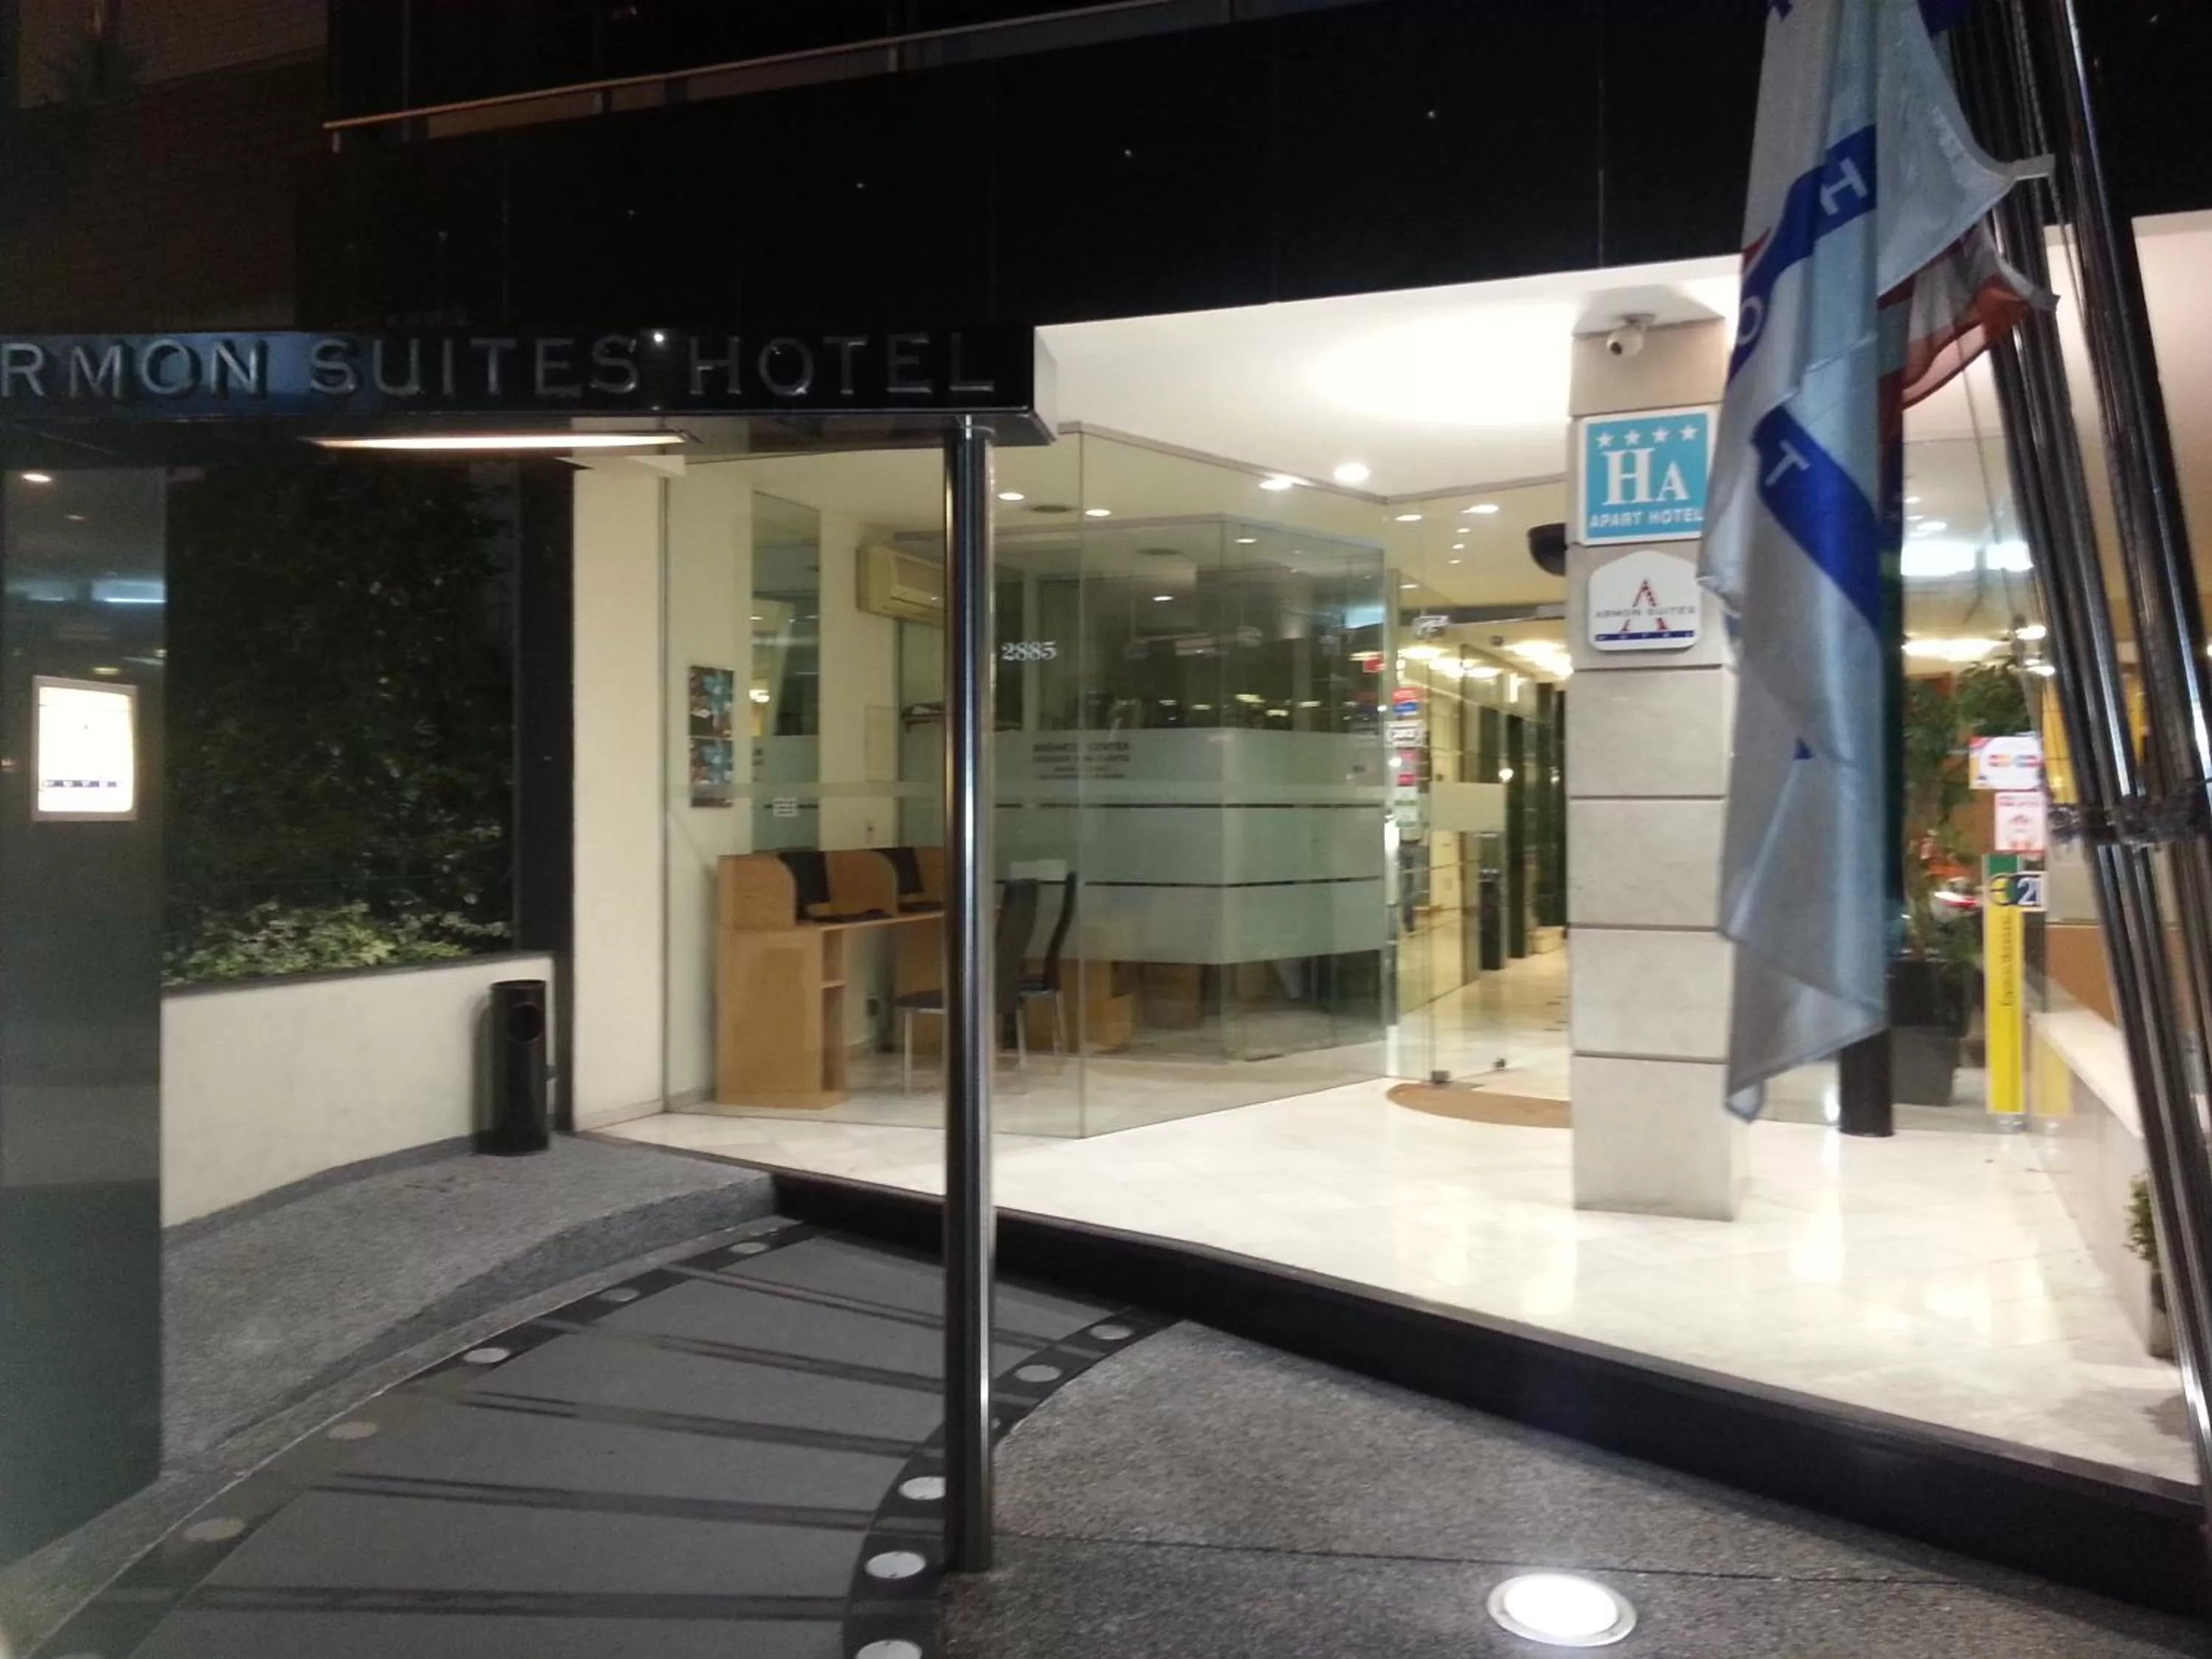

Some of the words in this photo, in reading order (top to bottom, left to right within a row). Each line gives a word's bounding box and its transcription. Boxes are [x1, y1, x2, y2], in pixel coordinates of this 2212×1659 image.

[1, 338, 259, 397] RMON
[310, 333, 640, 397] SUITES
[689, 331, 995, 396] HOTEL
[1601, 447, 1691, 506] HA
[1589, 510, 1643, 528] APART
[1648, 507, 1705, 525] HOTEL
[1001, 641, 1057, 661] 2885
